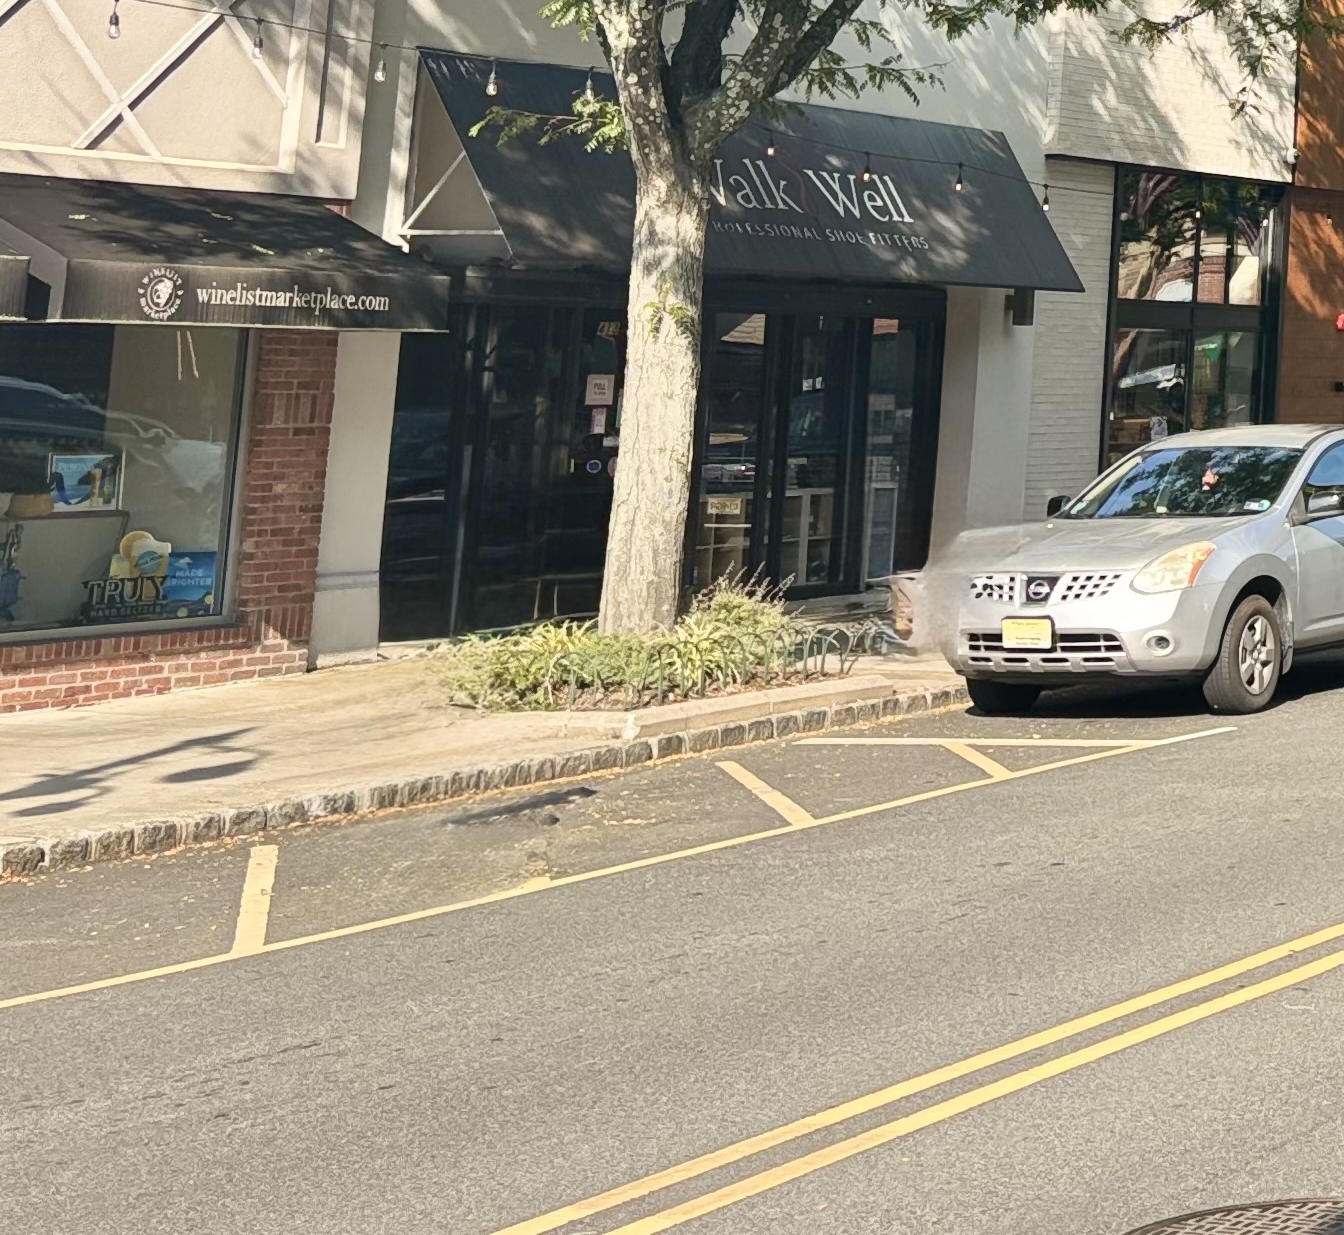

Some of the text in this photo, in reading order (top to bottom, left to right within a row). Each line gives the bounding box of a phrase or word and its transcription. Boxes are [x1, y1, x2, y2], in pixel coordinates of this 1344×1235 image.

[803, 169, 914, 222] Well
[197, 282, 389, 315] winelistmarketplace.com
[176, 568, 204, 577] MADE
[87, 576, 169, 605] TRULY
